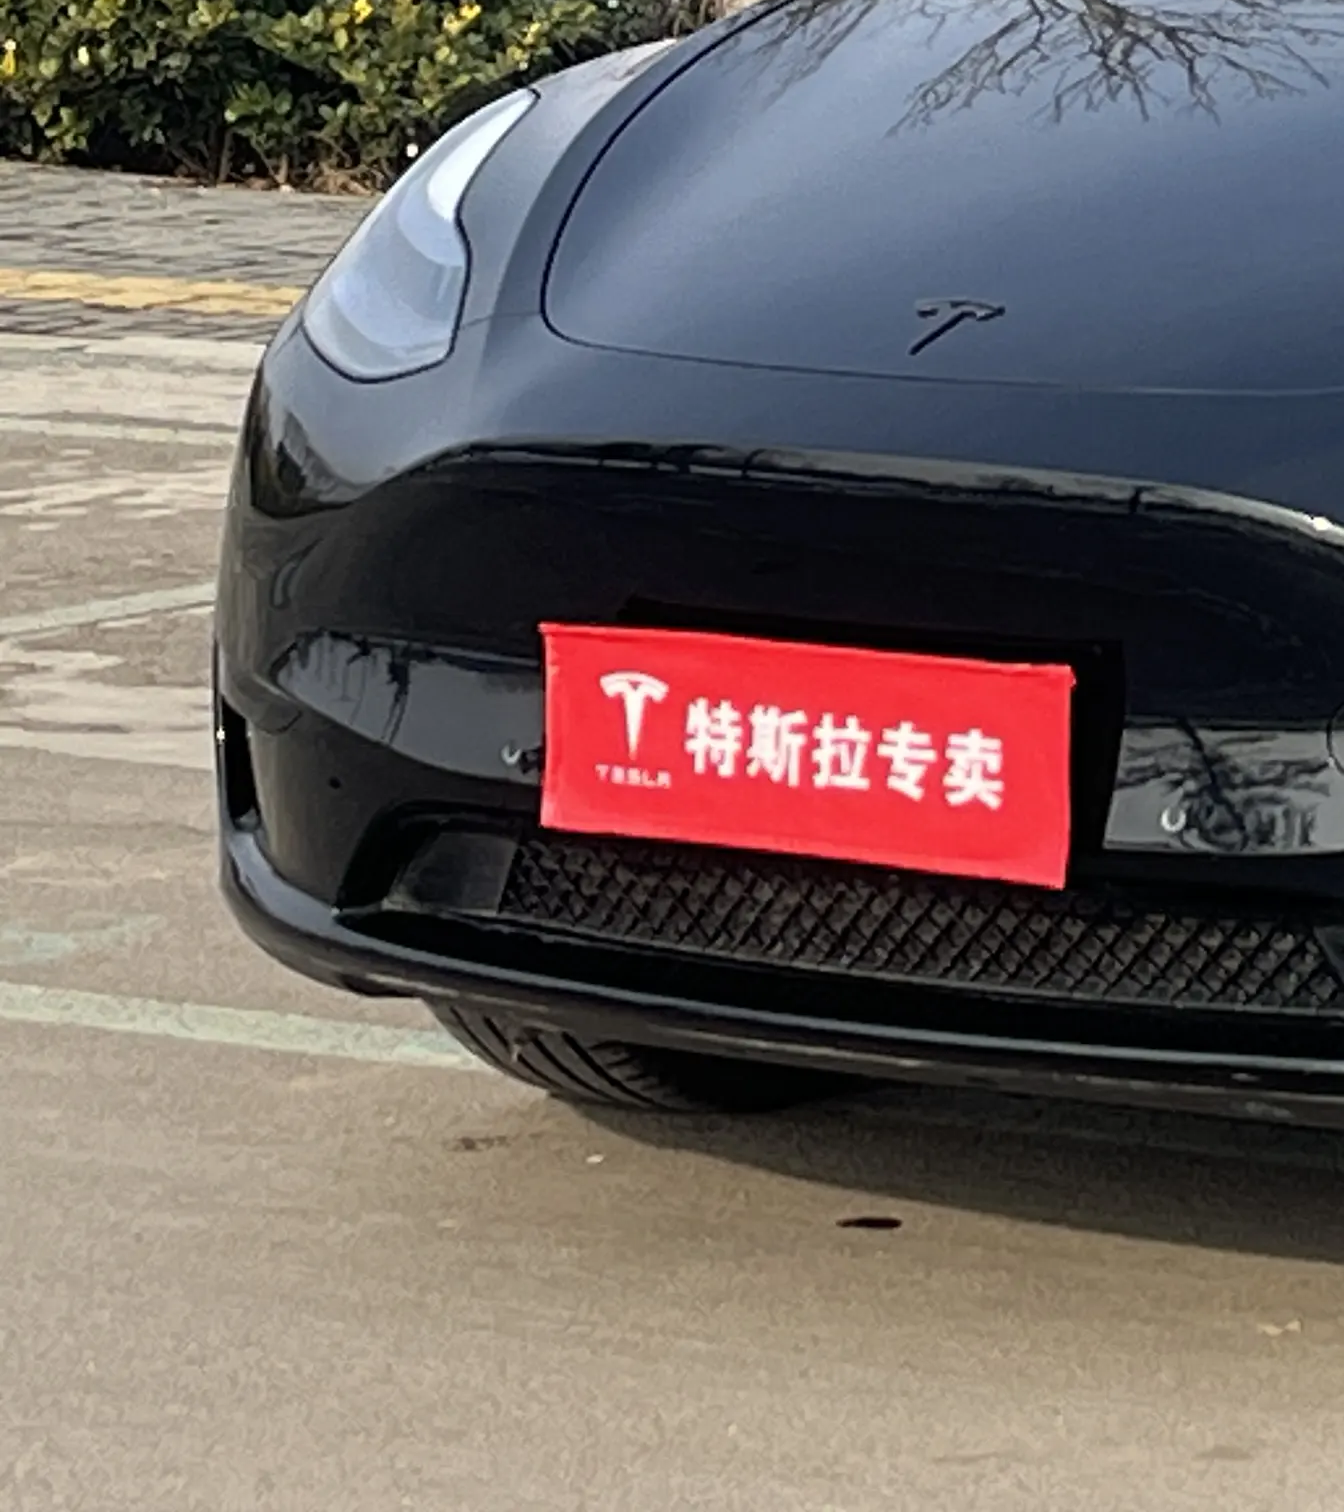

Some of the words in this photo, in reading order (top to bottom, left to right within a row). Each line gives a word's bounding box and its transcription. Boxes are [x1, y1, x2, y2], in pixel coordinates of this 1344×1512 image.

[595, 764, 671, 789] TESLA
[685, 696, 1005, 809] 特斯拉专卖
